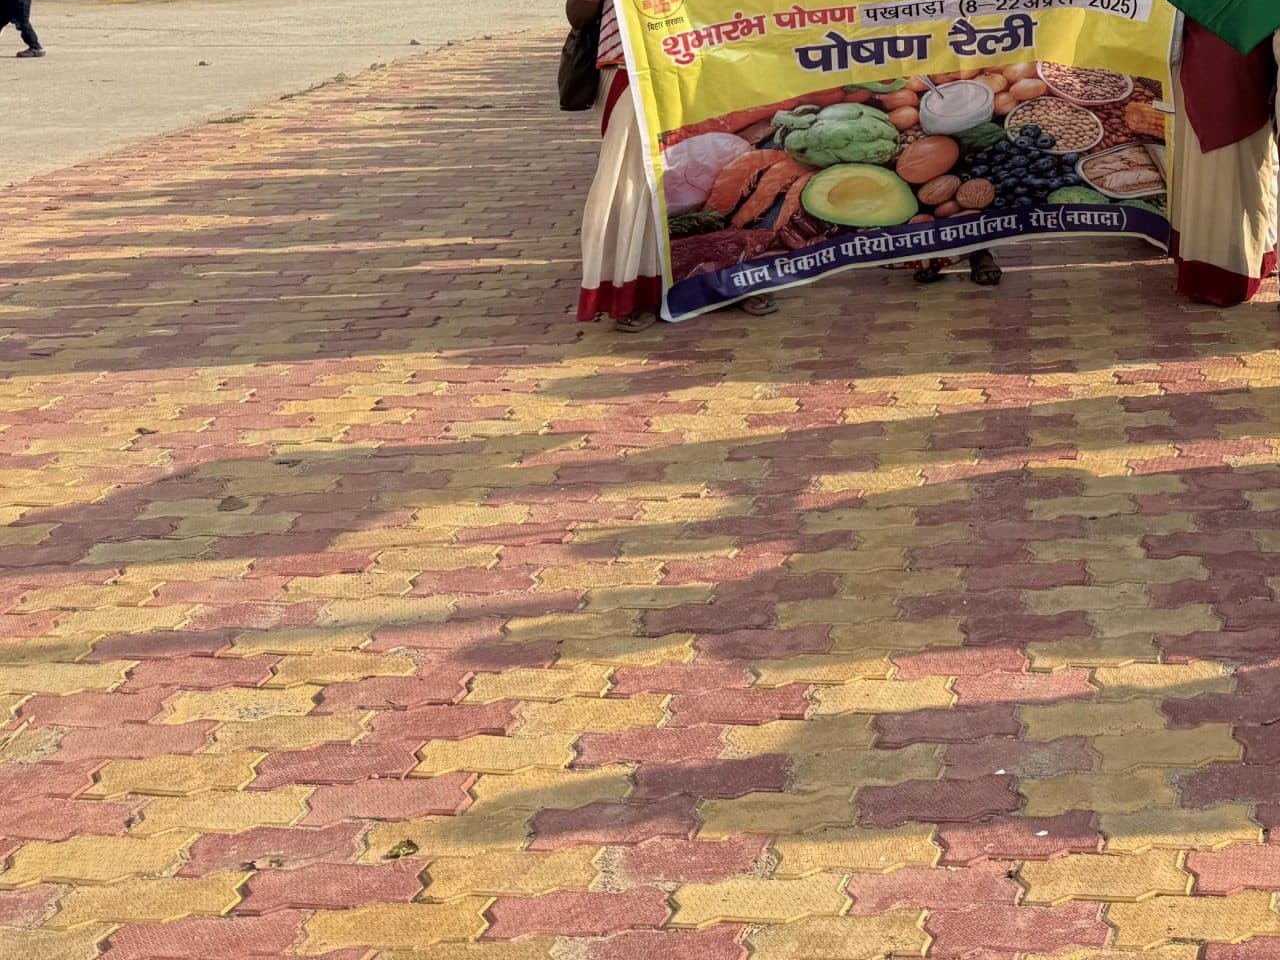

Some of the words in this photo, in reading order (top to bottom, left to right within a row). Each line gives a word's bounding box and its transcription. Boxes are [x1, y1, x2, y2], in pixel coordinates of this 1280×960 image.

[662, 11, 767, 65] शुभारंभ
[772, 4, 857, 29] पोषण
[864, 0, 945, 22] पखवाड़ा
[794, 31, 932, 72] पोषण
[948, 13, 1038, 56] रैली
[730, 264, 772, 287] बाल
[773, 246, 836, 278] विकास
[839, 232, 936, 257] परियोजना
[939, 215, 1024, 242] कार्यालय,
